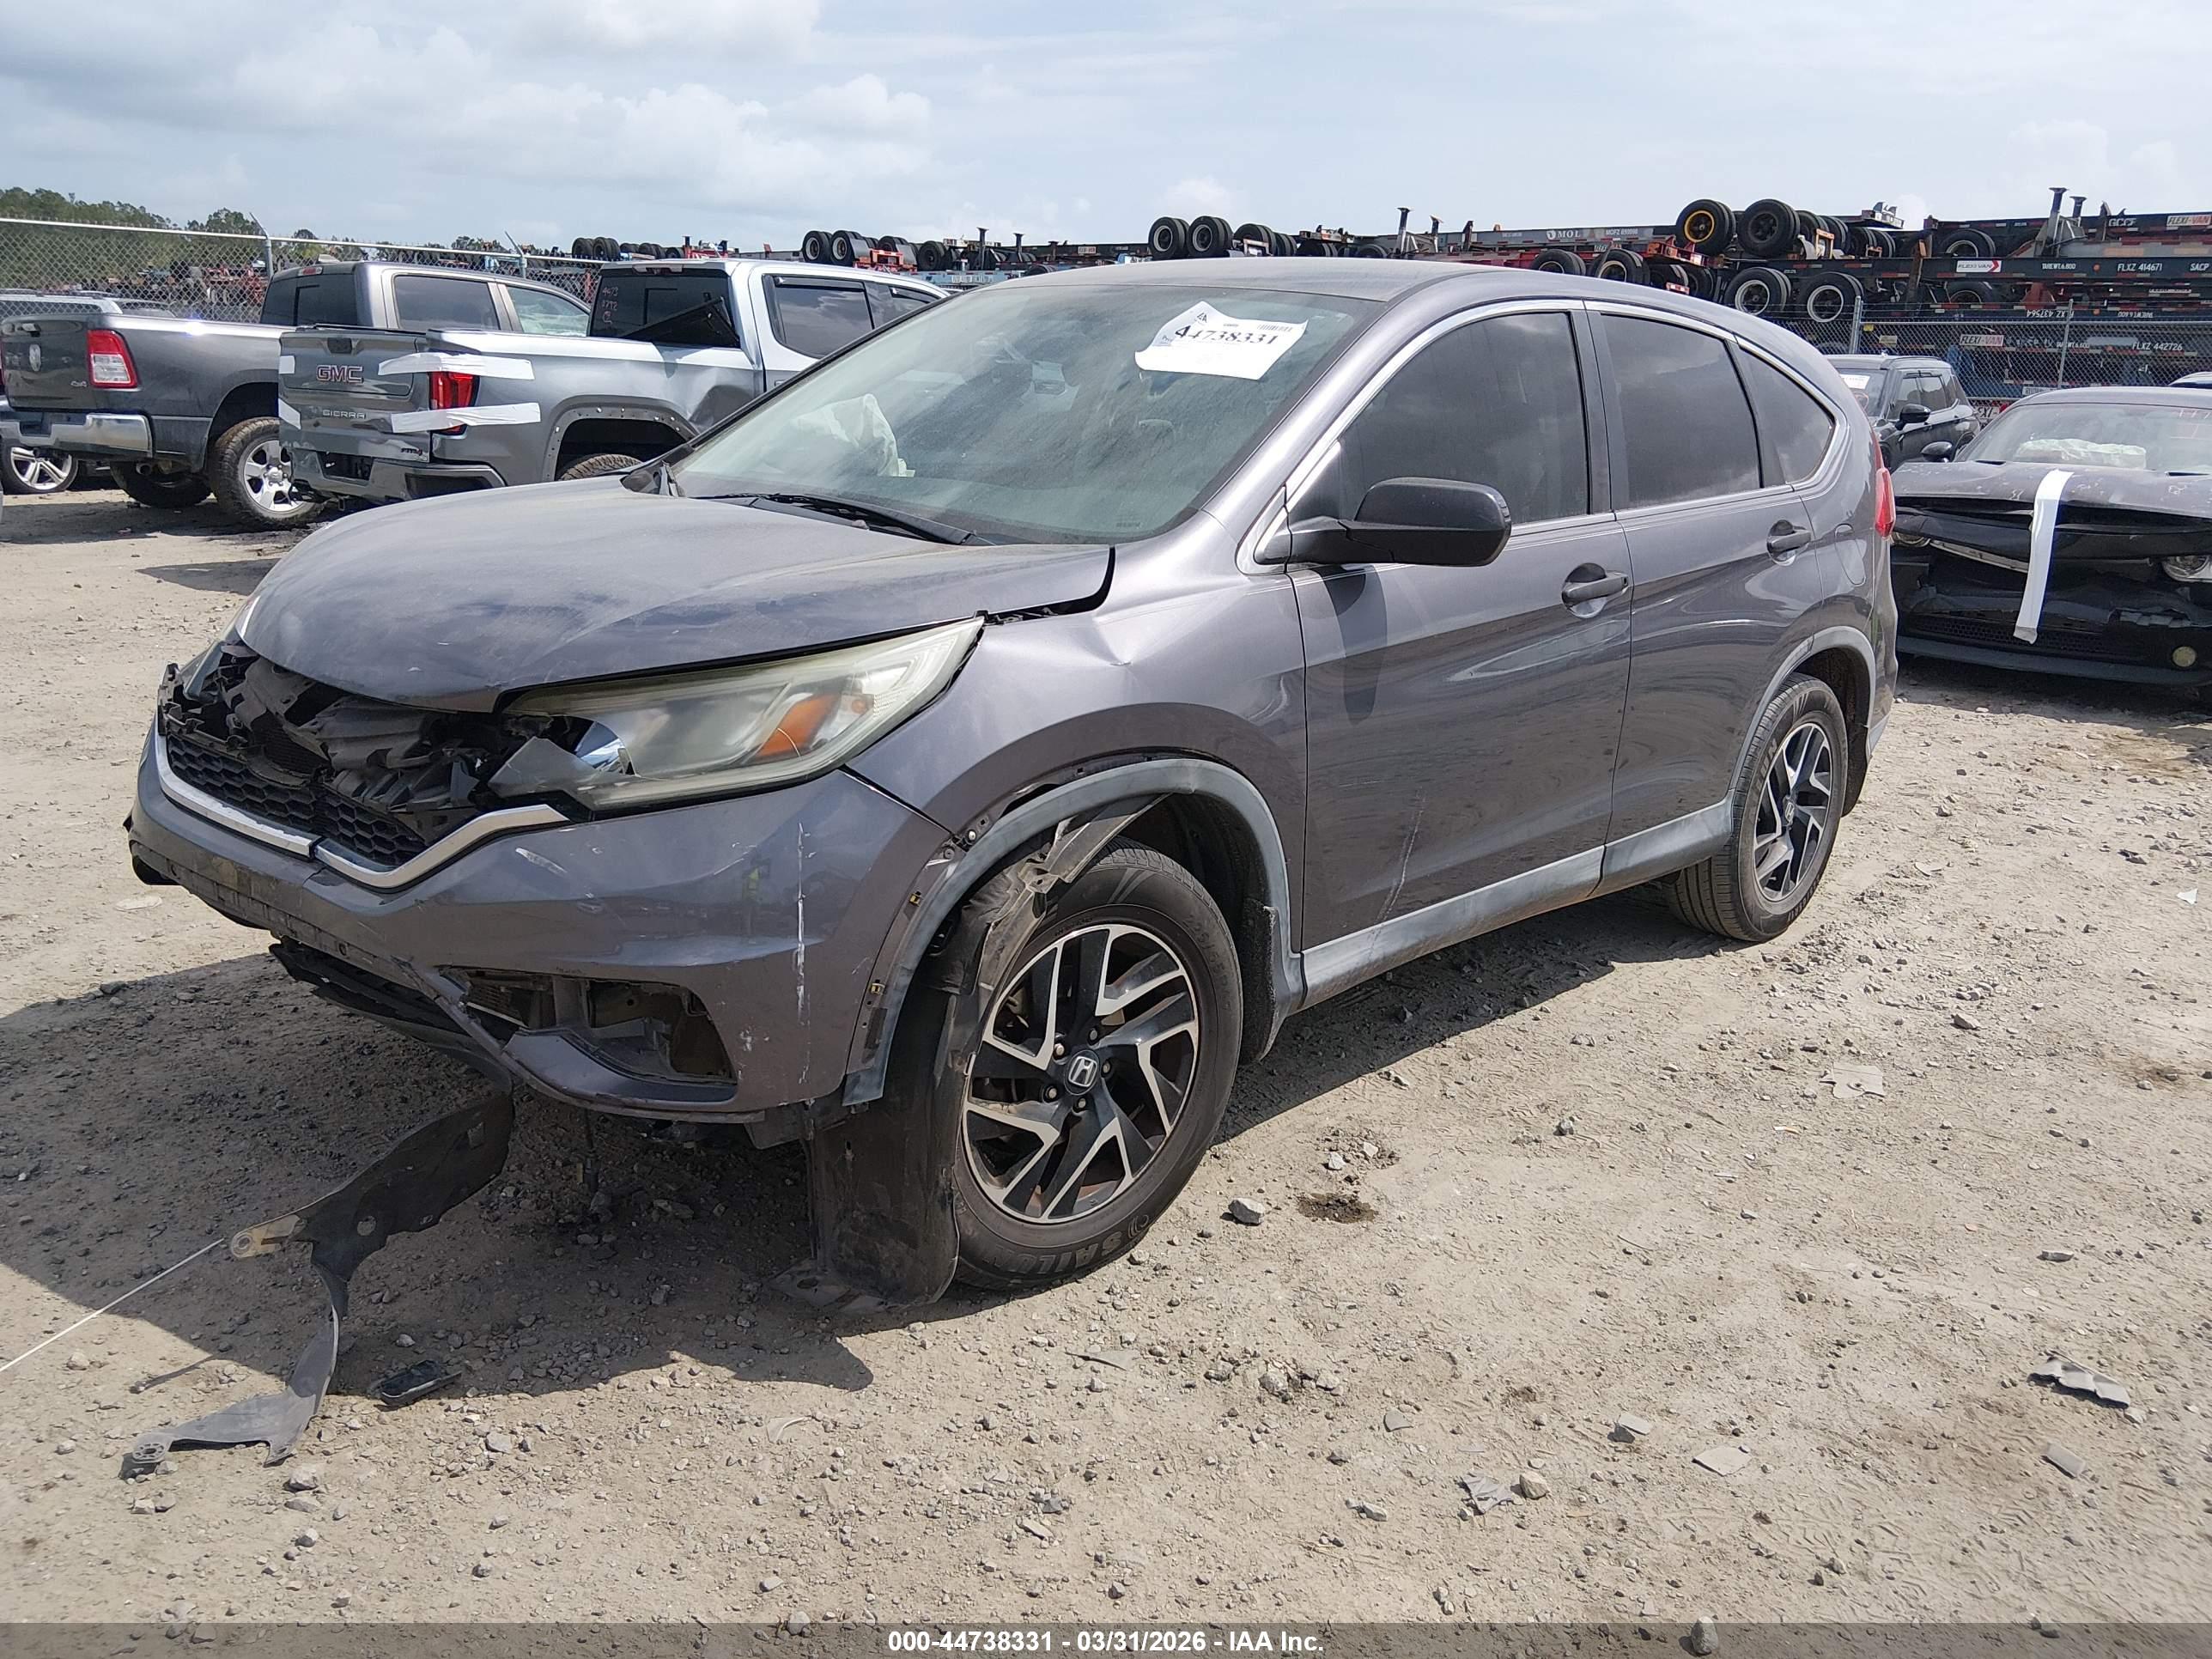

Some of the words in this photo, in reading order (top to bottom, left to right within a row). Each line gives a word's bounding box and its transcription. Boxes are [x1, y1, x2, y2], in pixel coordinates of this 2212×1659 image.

[2118, 263, 2136, 271] FLXZ
[2138, 263, 2162, 271] 414671
[1175, 325, 1279, 344] 44738331
[1960, 335, 2003, 345] FLEXI-VAN
[316, 364, 364, 383] GMC
[322, 409, 366, 419] SIERRA
